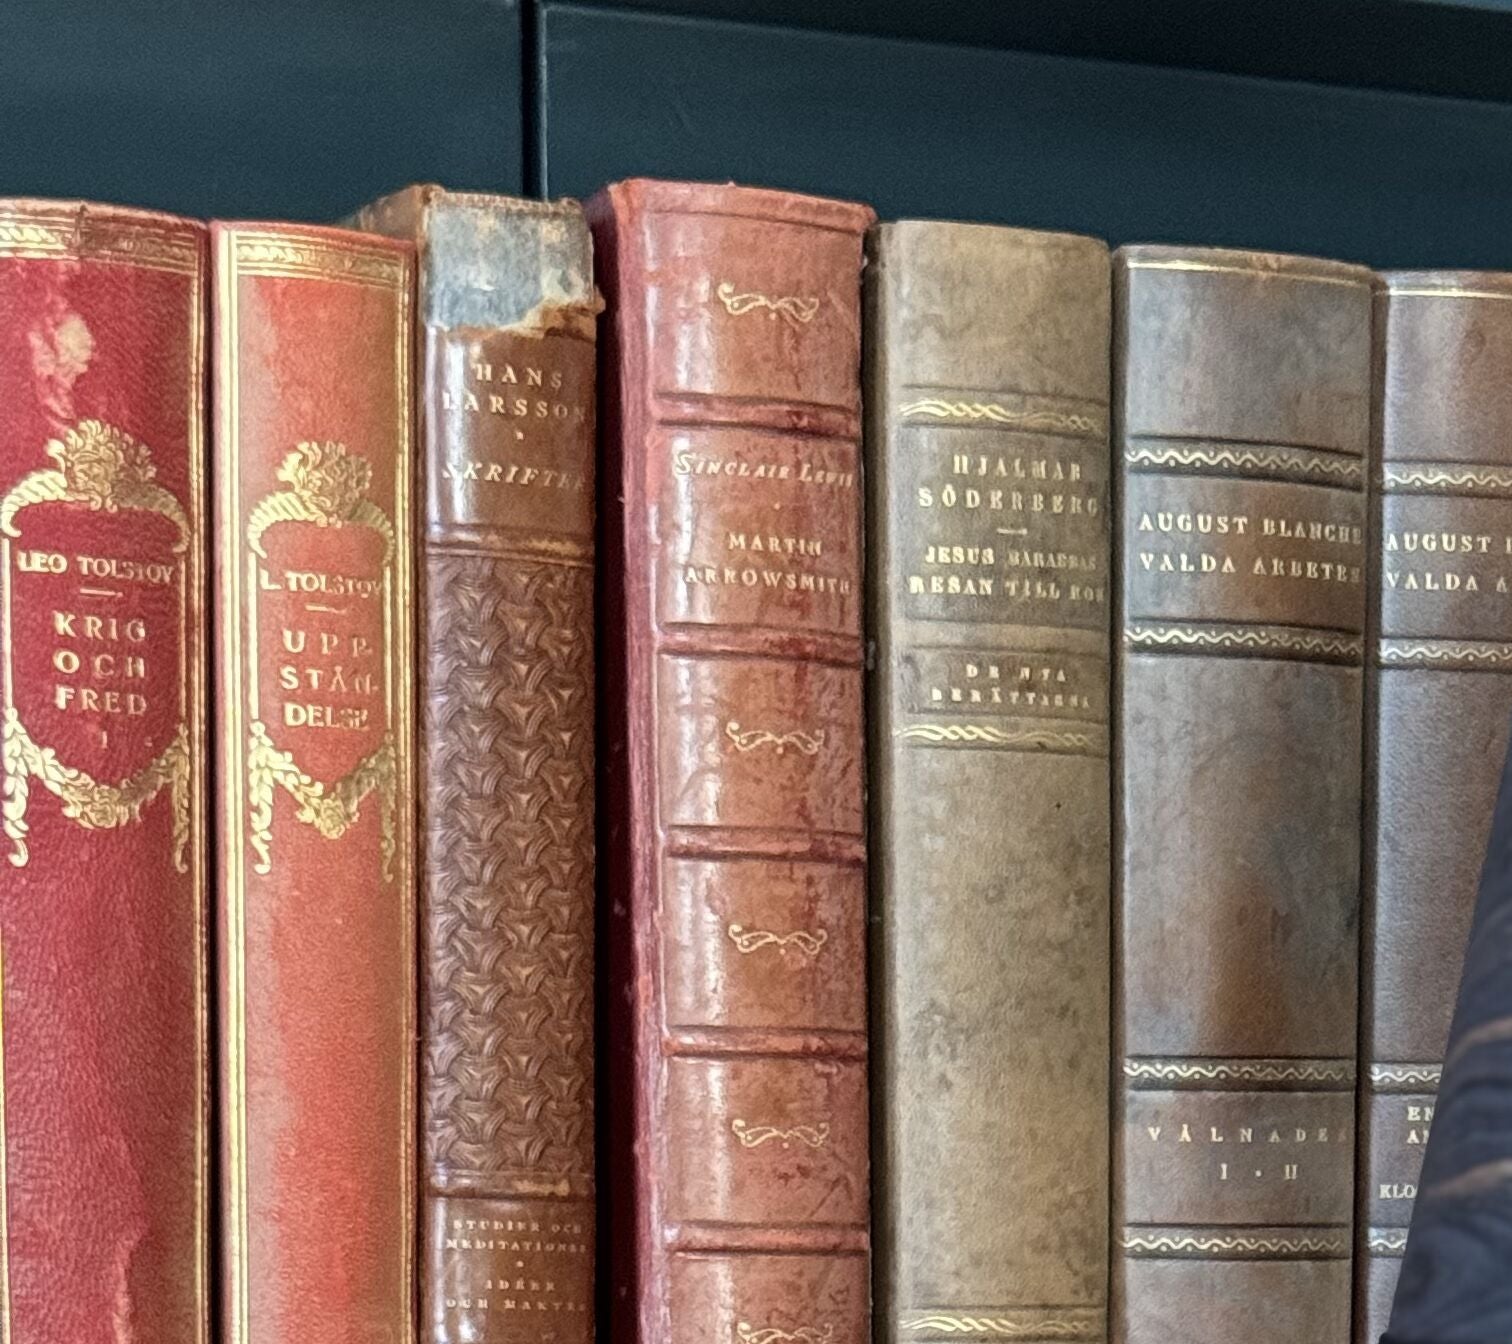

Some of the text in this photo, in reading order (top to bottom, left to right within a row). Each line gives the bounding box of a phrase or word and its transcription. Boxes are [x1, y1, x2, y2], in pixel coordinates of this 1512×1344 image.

[475, 363, 563, 390] HANS
[442, 391, 587, 424] LARSSON
[952, 454, 1082, 483] HJALMAR
[917, 483, 1099, 518] SÖDERBERG
[1138, 511, 1363, 545] AUGUST BLANCHE
[727, 532, 823, 557] MARTIN
[924, 546, 996, 566] JESUS
[1384, 532, 1492, 554] AUGUST
[18, 552, 175, 582] LEO TOLSTOY
[1138, 552, 1237, 574] VALDA
[285, 569, 382, 598] TOLSTOY
[684, 566, 851, 595] ARROWSMITH
[908, 575, 1061, 601] RESAN TILL
[1384, 571, 1479, 591] VALDA
[53, 611, 147, 642] KRIG
[53, 651, 146, 680] OCH
[55, 686, 148, 715] FRED
[285, 702, 370, 731] DELSE
[1220, 1163, 1299, 1180] I II
[453, 1218, 583, 1235] STUDIER OCH
[446, 1298, 489, 1310] OCH
